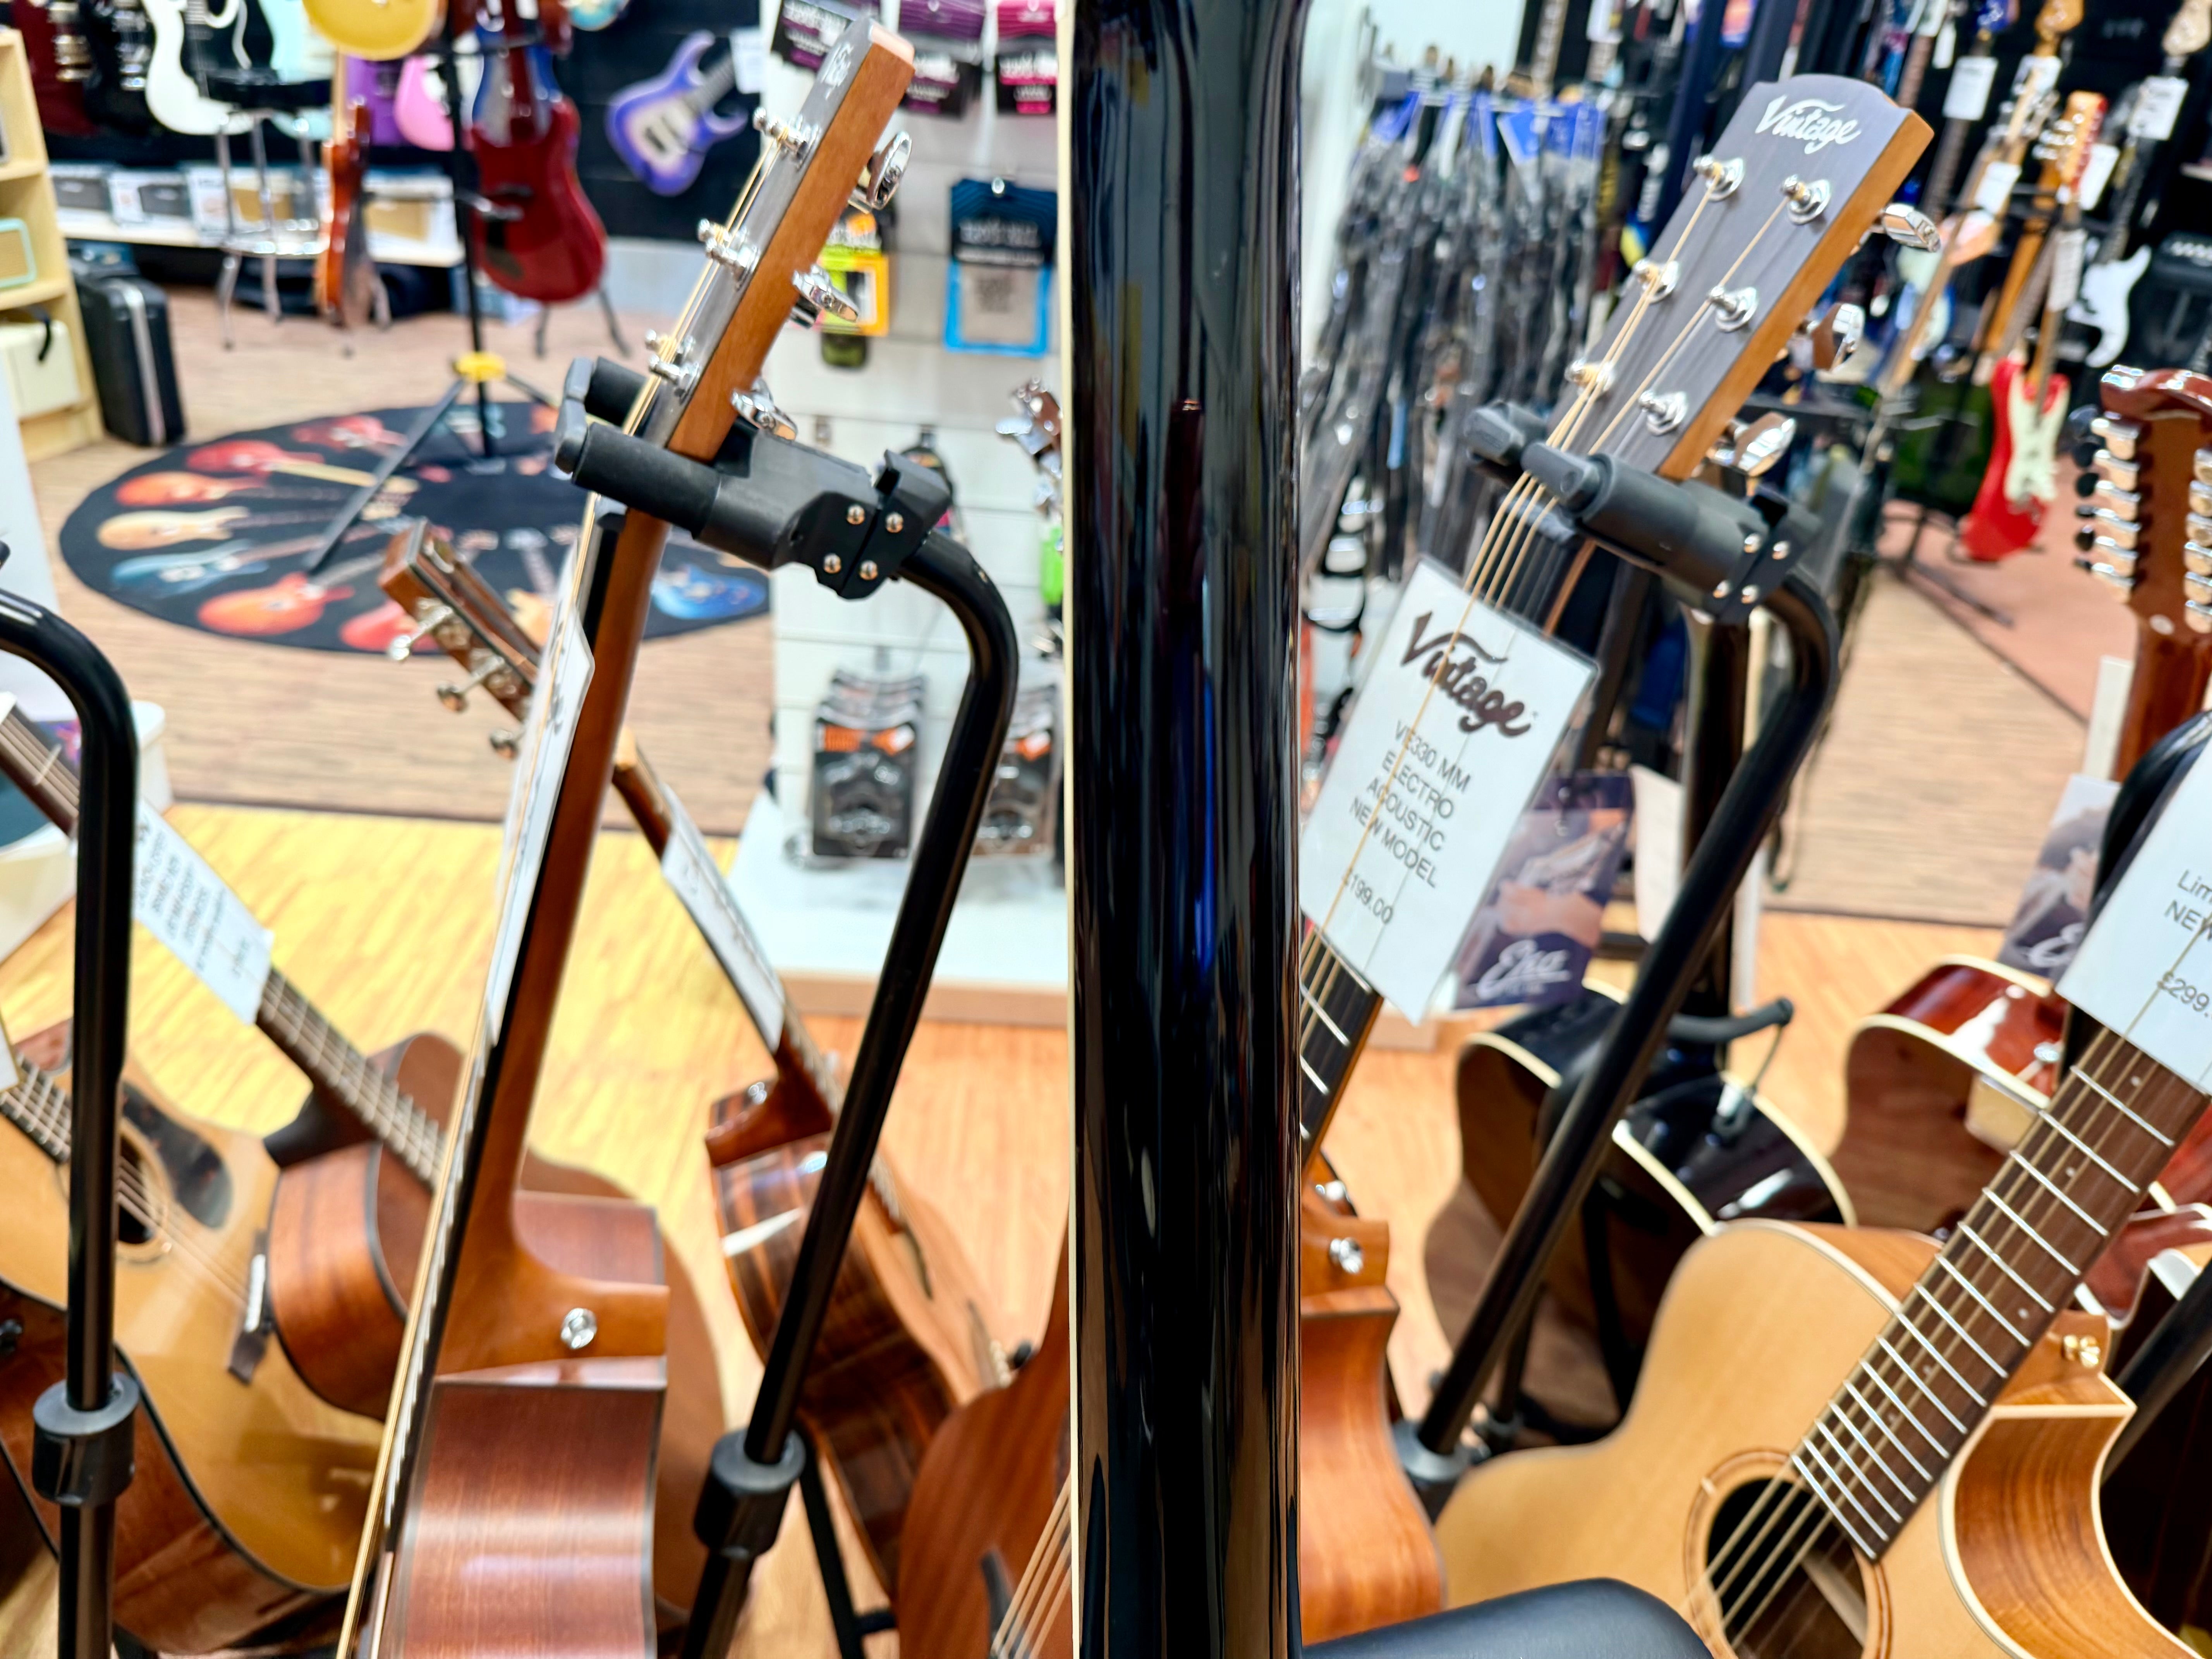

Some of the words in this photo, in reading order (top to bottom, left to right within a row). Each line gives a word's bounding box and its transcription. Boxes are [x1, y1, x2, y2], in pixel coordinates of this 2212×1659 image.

[1755, 95, 1862, 155] Vintage
[1400, 610, 1532, 738] Vintage
[1437, 756, 1471, 793] MM
[1366, 777, 1445, 852] ACOUSTIC
[1380, 827, 1436, 888] MODEL
